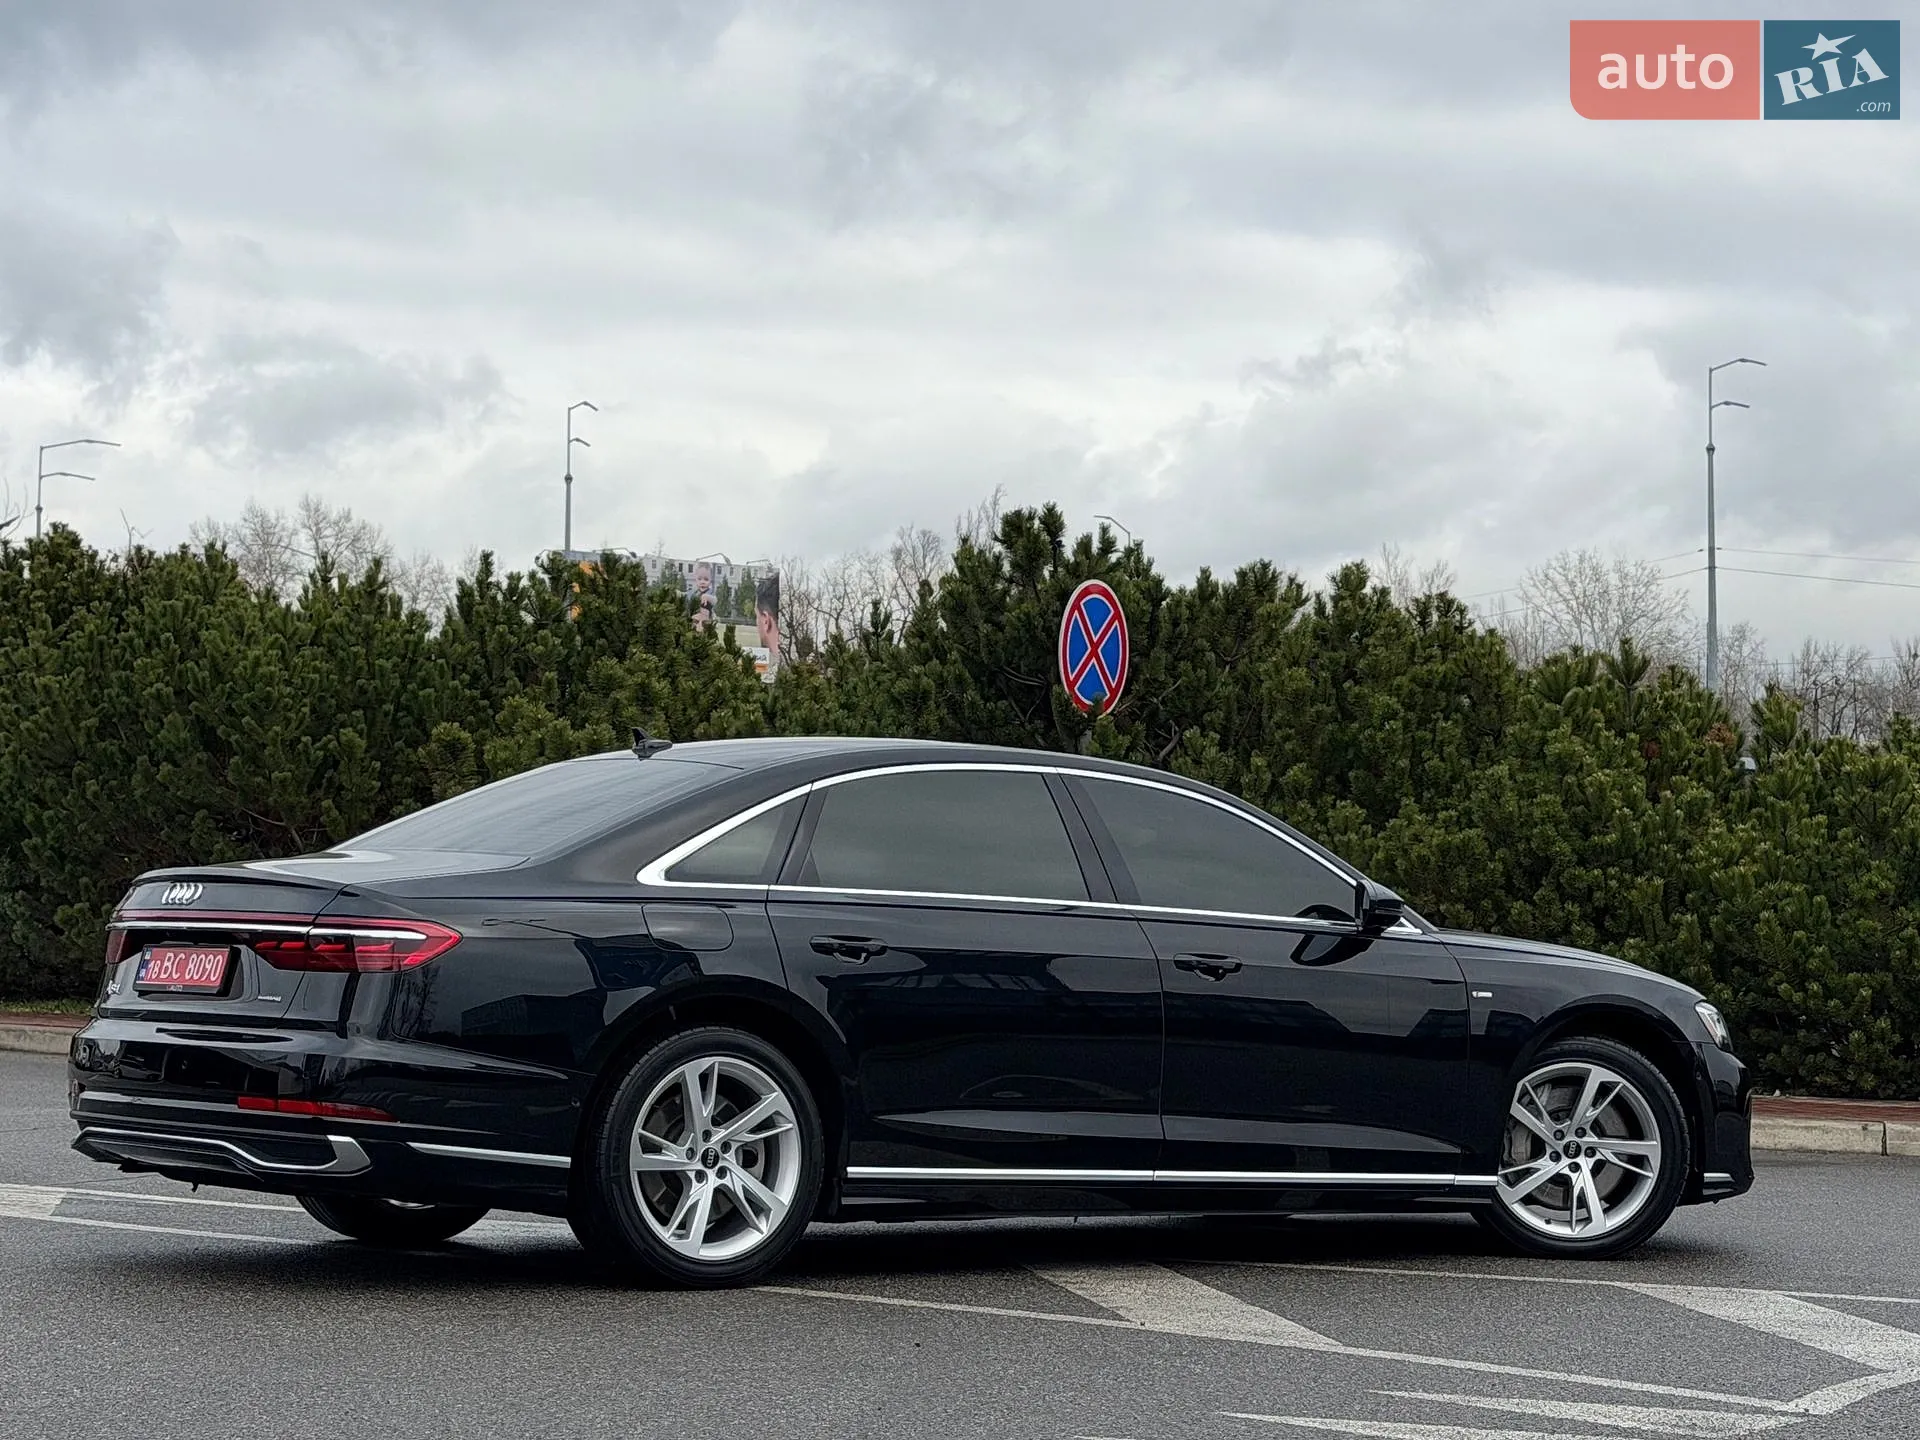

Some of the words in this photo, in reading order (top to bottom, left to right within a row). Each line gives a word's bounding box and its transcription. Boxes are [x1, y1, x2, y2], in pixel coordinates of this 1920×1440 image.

[147, 960, 161, 980] 18
[160, 952, 185, 980] BC
[185, 953, 223, 981] 8090
